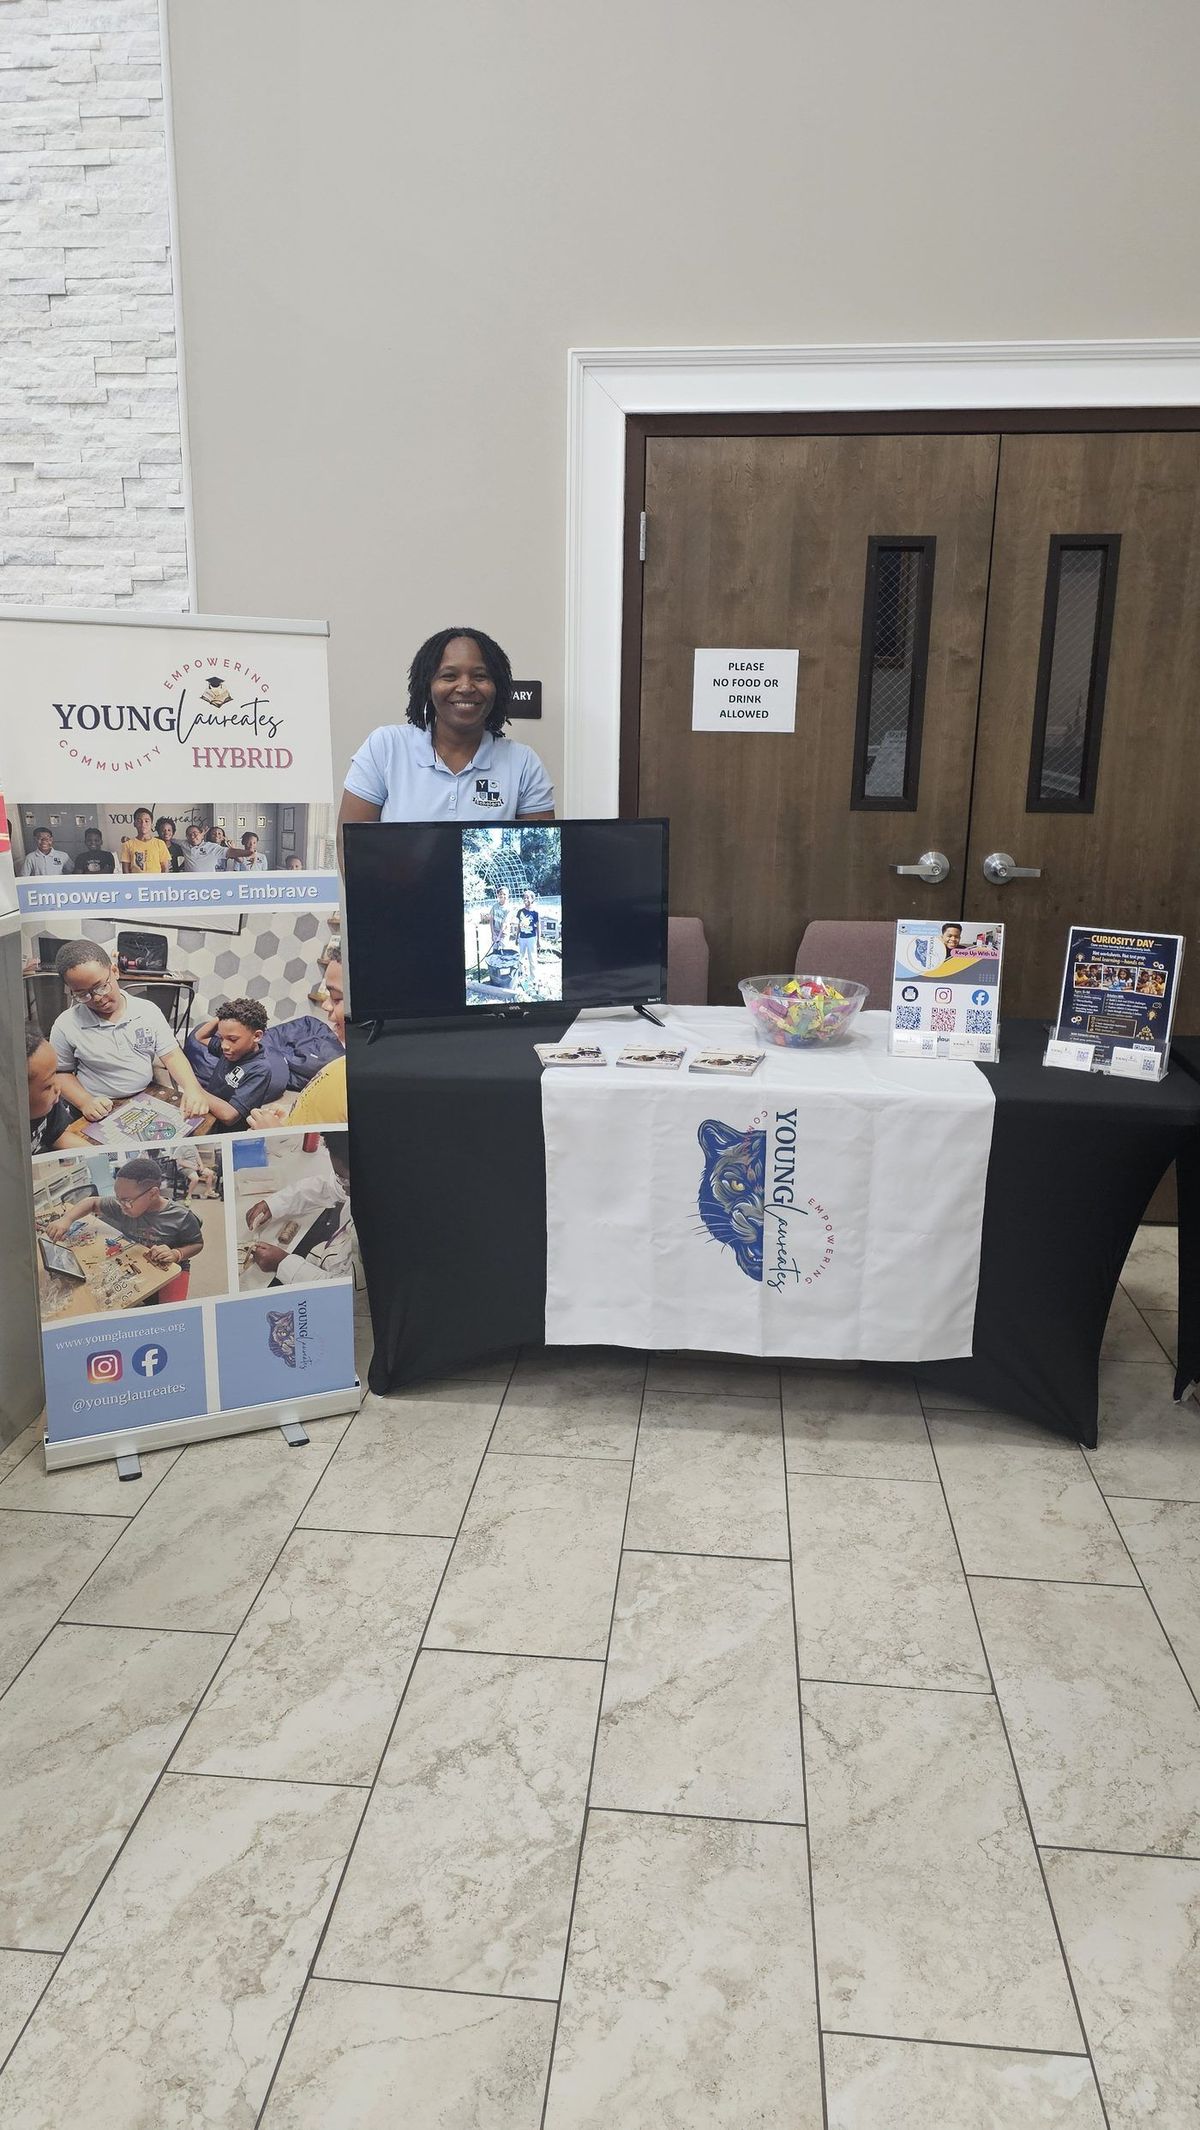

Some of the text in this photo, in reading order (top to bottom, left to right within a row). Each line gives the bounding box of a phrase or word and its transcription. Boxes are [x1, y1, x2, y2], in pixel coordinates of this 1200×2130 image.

[164, 657, 270, 693] EMPOWERING
[728, 662, 765, 671] PLEASE
[713, 679, 779, 687] NO FOOD OR
[728, 695, 761, 703] DRINK
[52, 704, 176, 731] YOUNG
[719, 710, 769, 719] ALLOWED
[59, 739, 161, 772] COMMUNITY
[192, 747, 294, 769] HYBRID
[27, 883, 318, 907] Empower Embrace Embrave
[1091, 935, 1135, 946] CURIOSITY
[1136, 939, 1155, 948] DAY
[773, 1108, 798, 1205] YOUNG
[805, 1197, 835, 1285] EMPOWERING
[297, 1300, 308, 1337] YOUNG
[55, 1321, 186, 1350] www.younglaureates.org
[72, 1382, 186, 1413] @younglaureates
